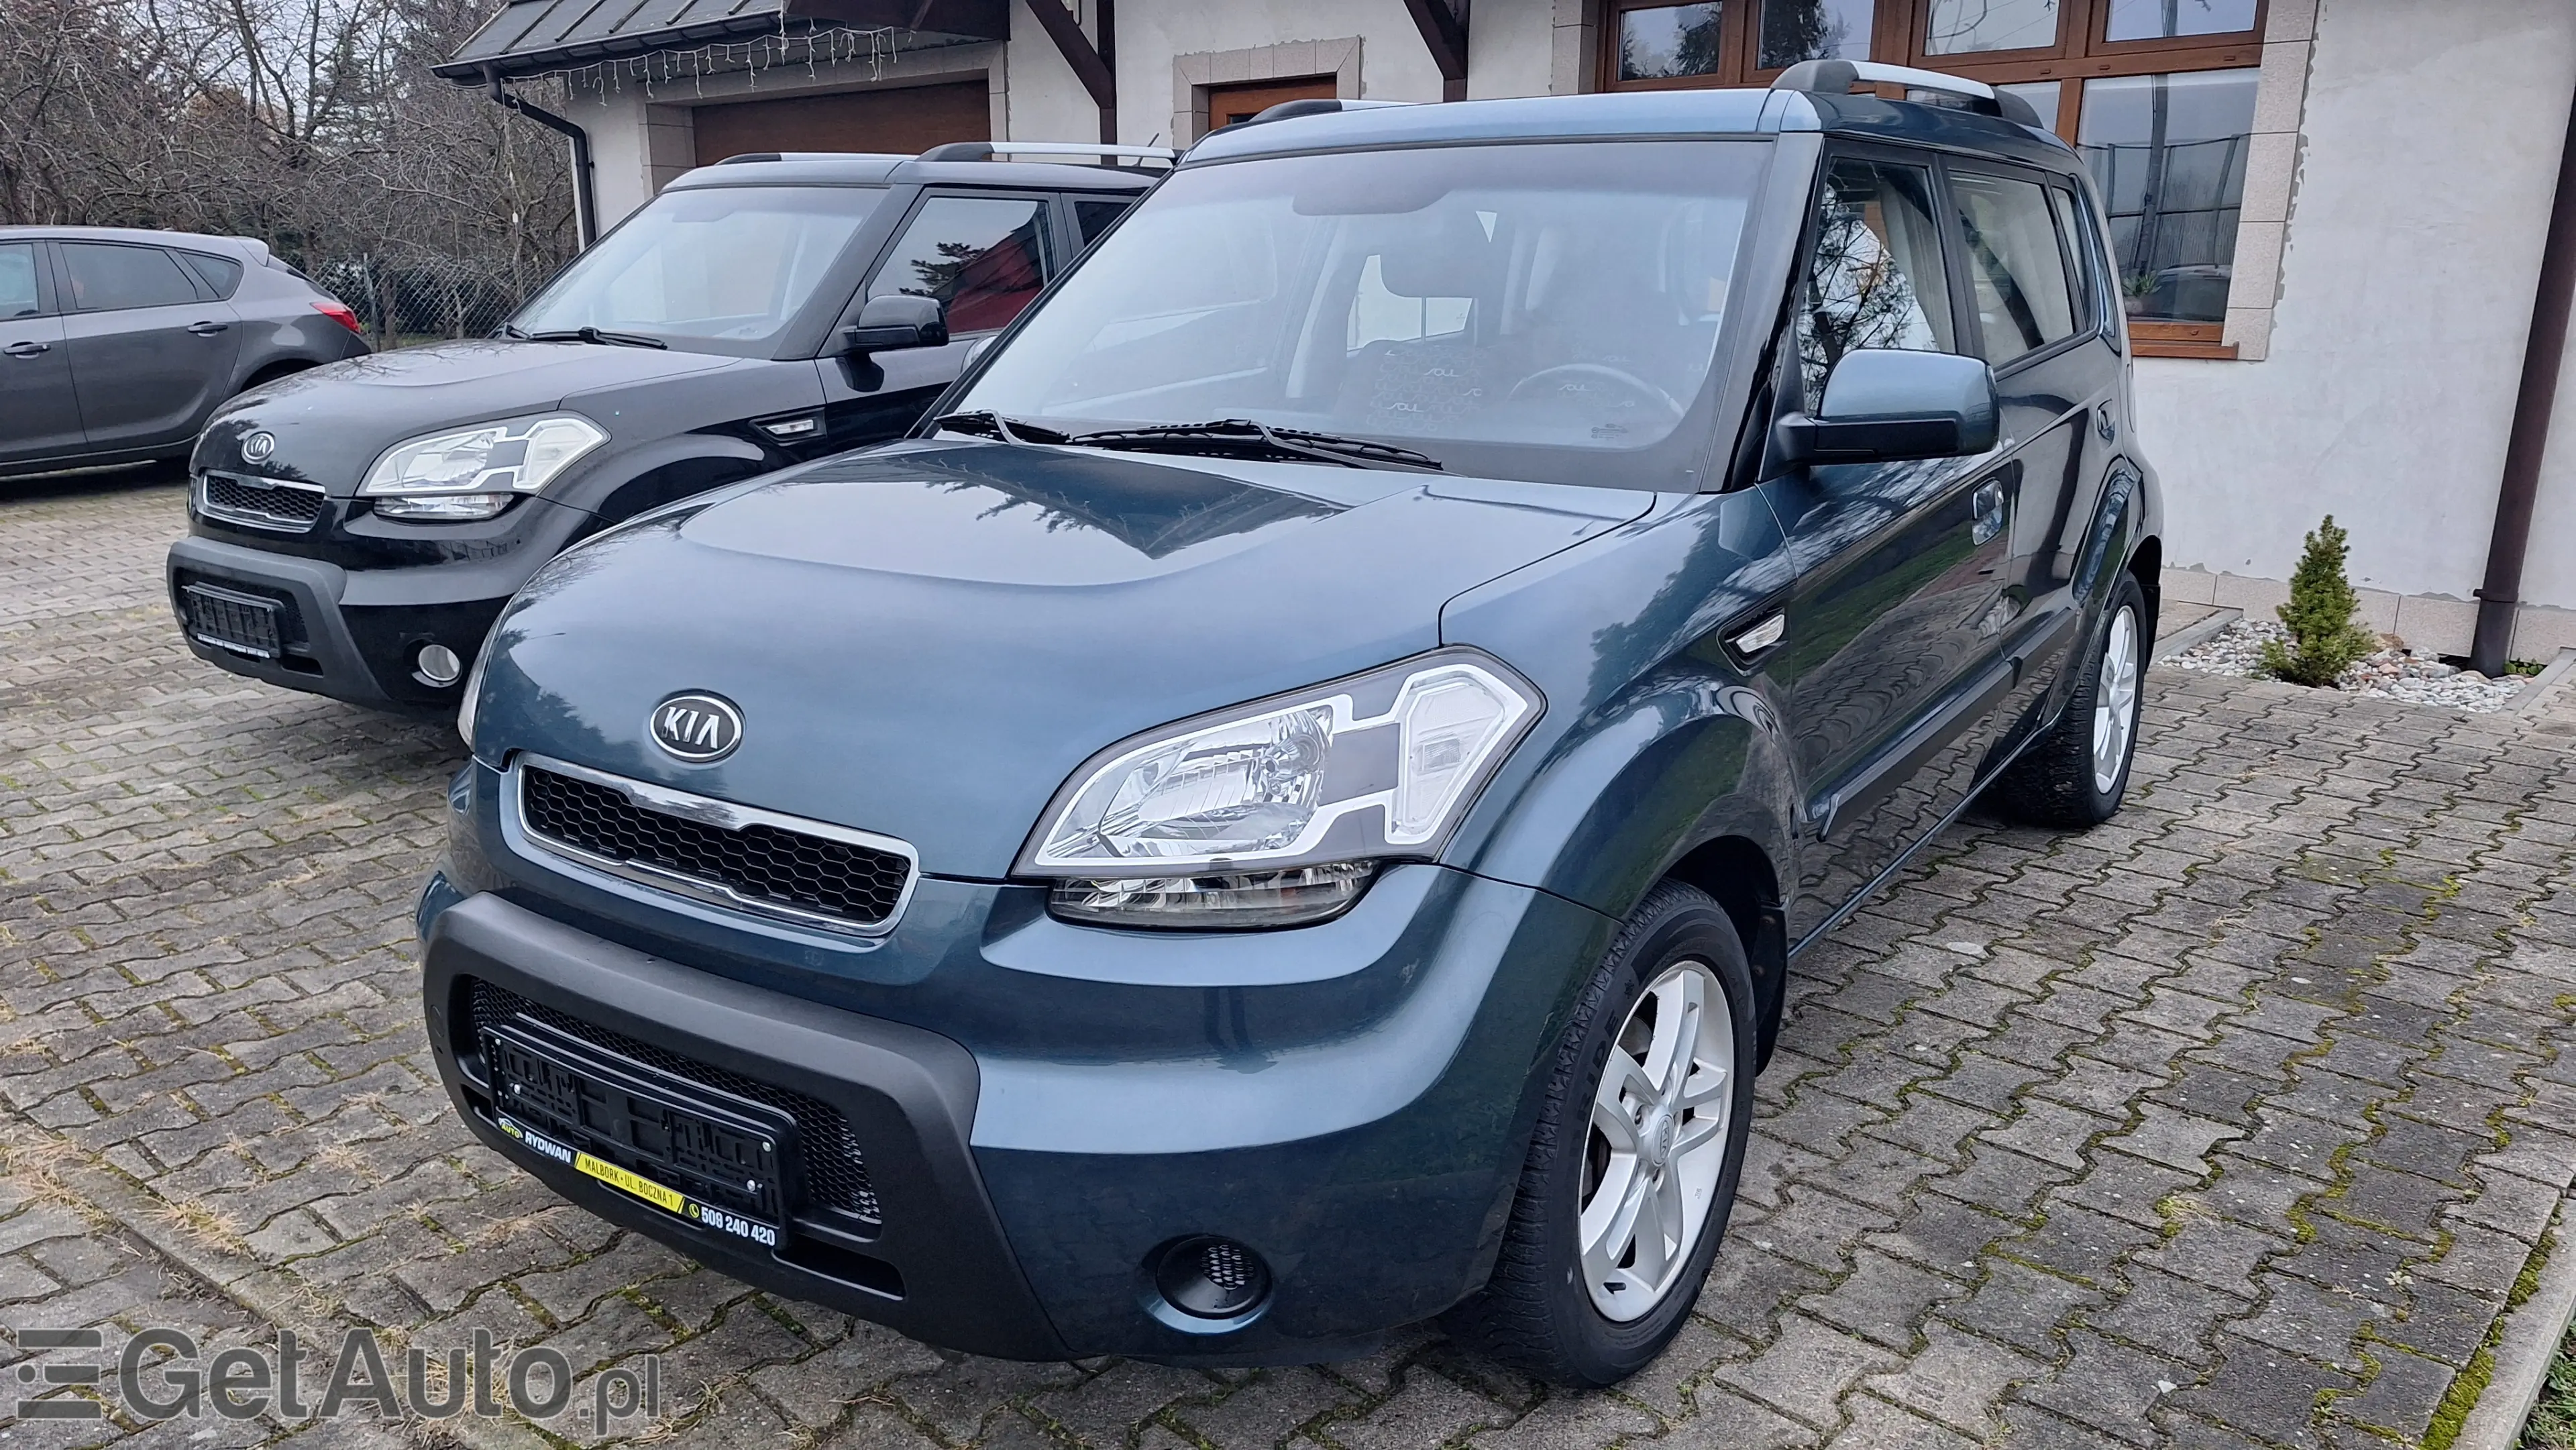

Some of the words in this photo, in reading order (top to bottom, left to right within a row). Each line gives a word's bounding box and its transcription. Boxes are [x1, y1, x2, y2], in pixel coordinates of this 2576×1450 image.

[661, 707, 720, 749] KIA
[501, 1123, 520, 1139] AUTO
[525, 1131, 572, 1163] RYDWAN
[584, 1157, 619, 1183] MALBORK
[639, 1181, 667, 1204] BOCZNA
[669, 1194, 674, 1206] 1
[701, 1206, 724, 1229] 509
[725, 1215, 749, 1238] 240
[751, 1225, 775, 1247] 420
